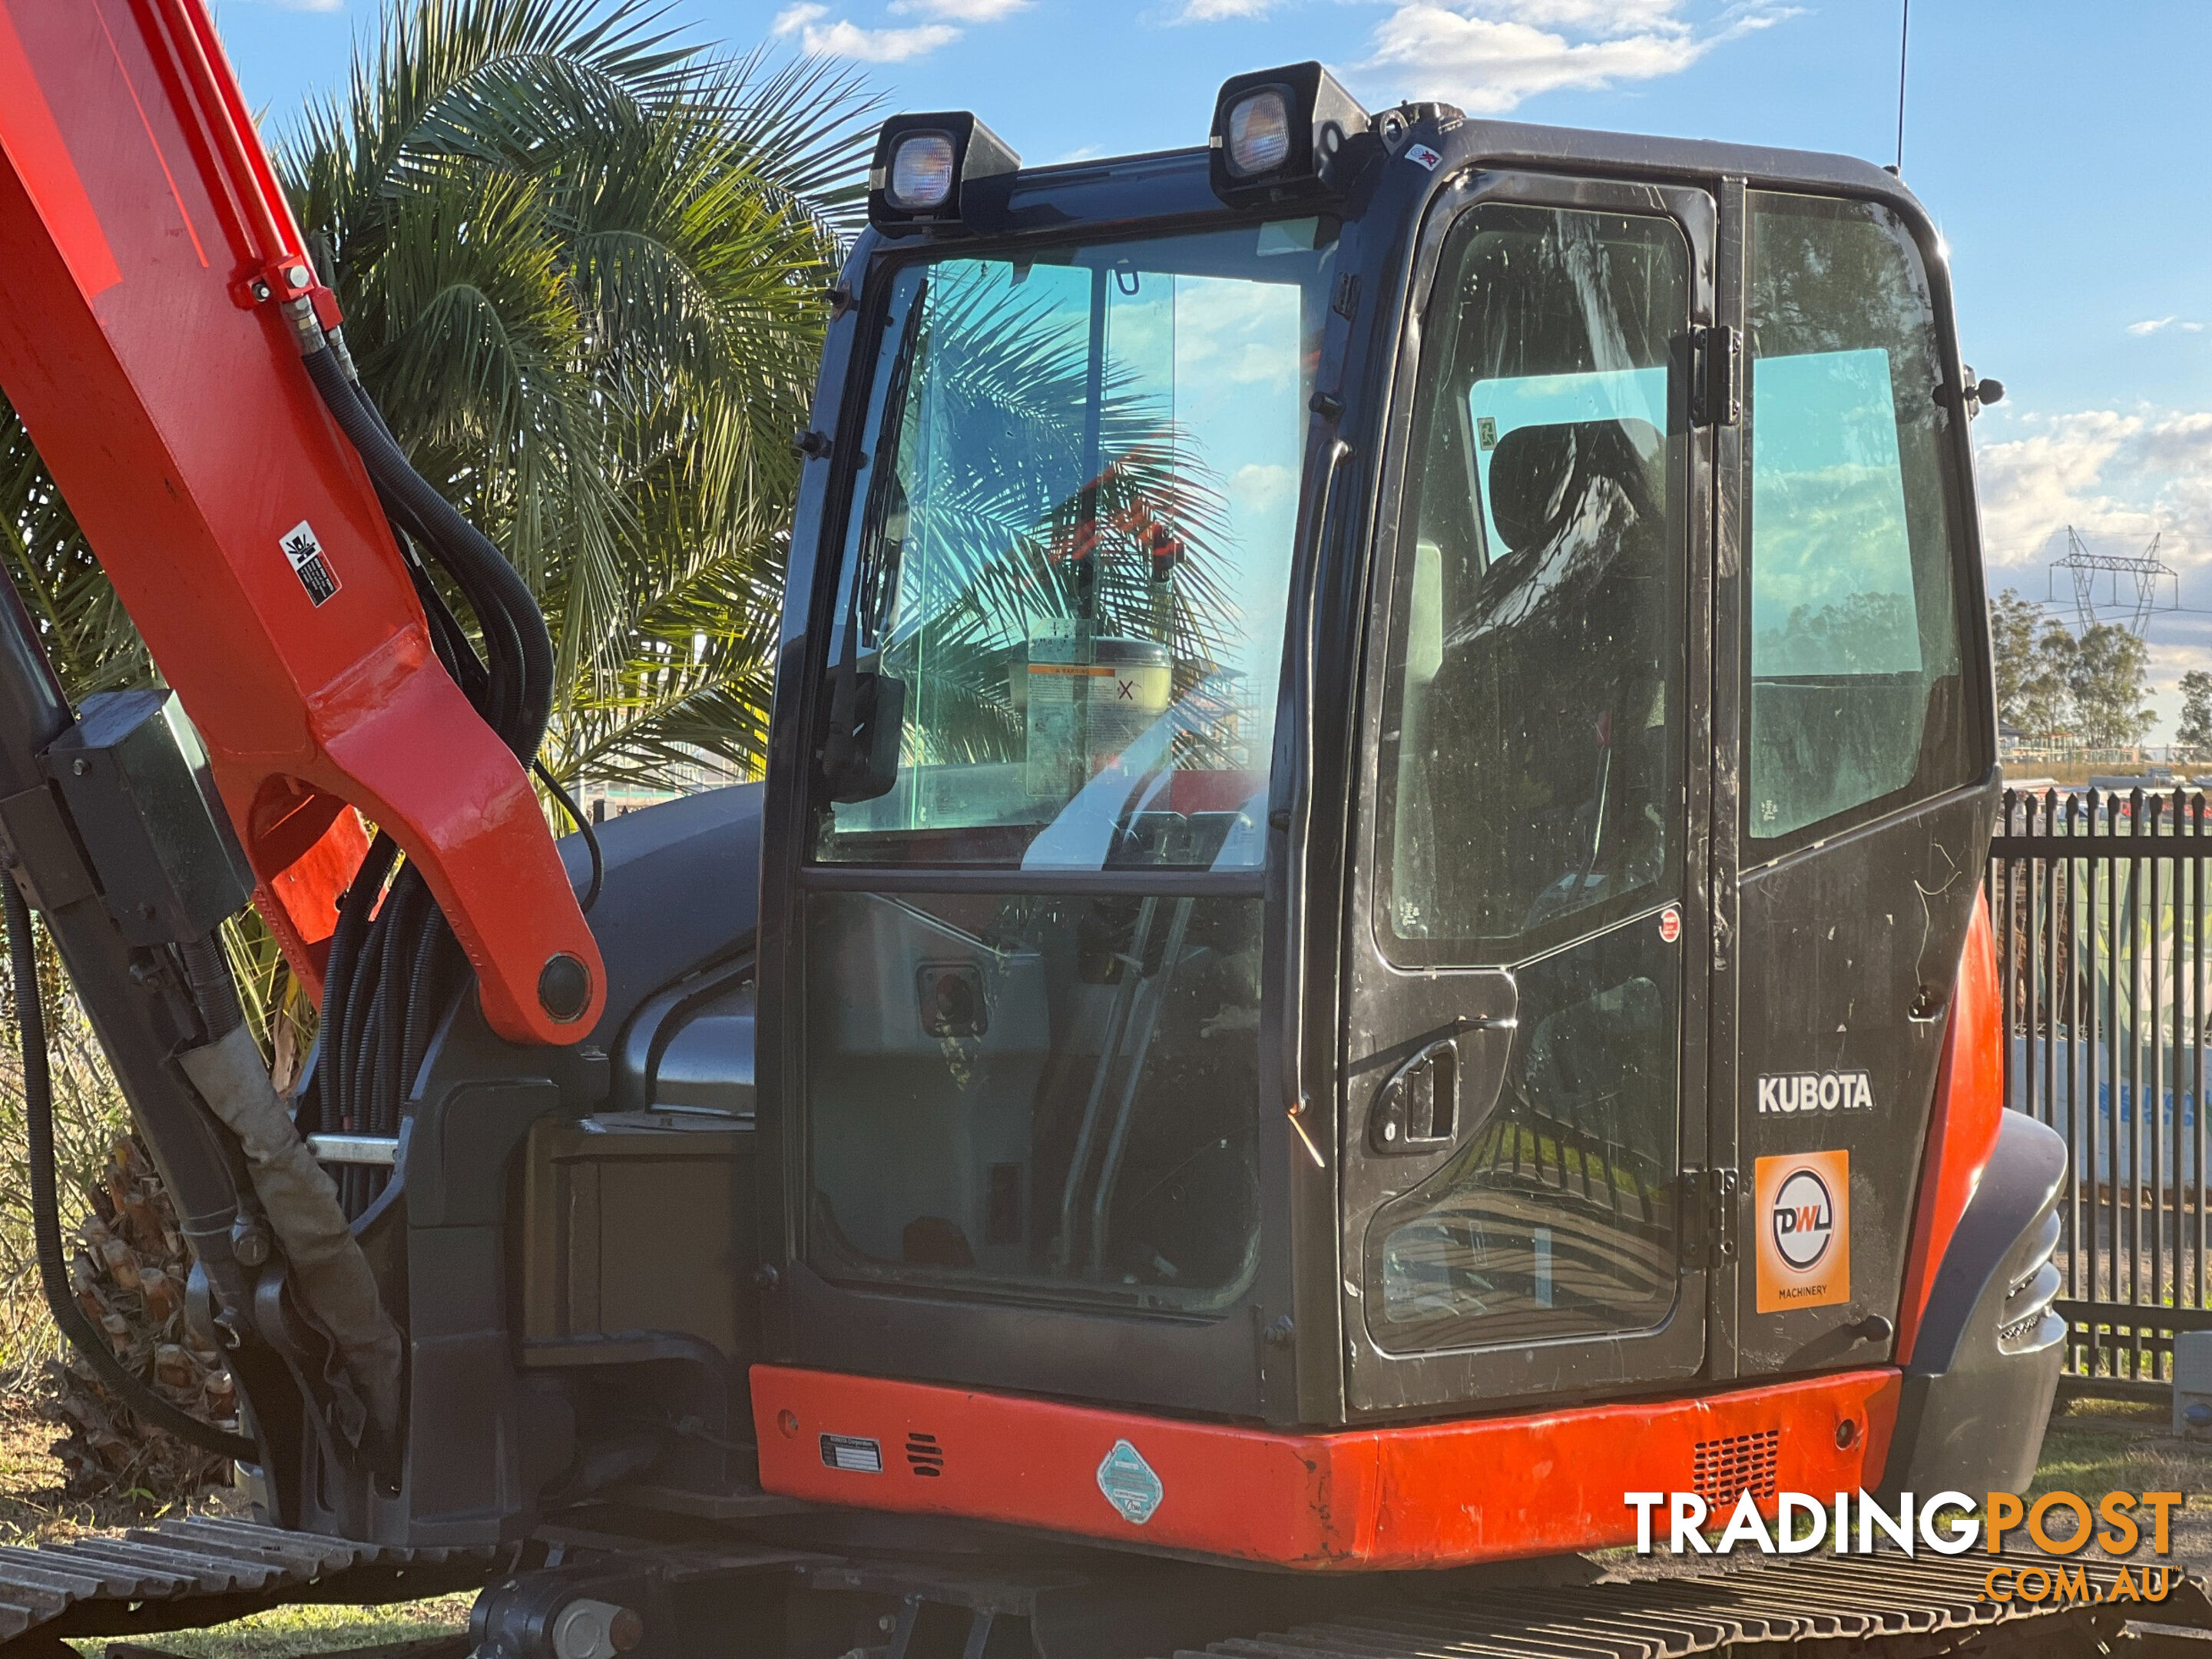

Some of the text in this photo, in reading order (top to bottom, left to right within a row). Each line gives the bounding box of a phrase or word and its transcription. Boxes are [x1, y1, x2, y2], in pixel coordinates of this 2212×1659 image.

[1759, 1075, 1873, 1113] KUBOTA
[1773, 1204, 1832, 1234] DWL
[1779, 1284, 1827, 1300] MACHINERY
